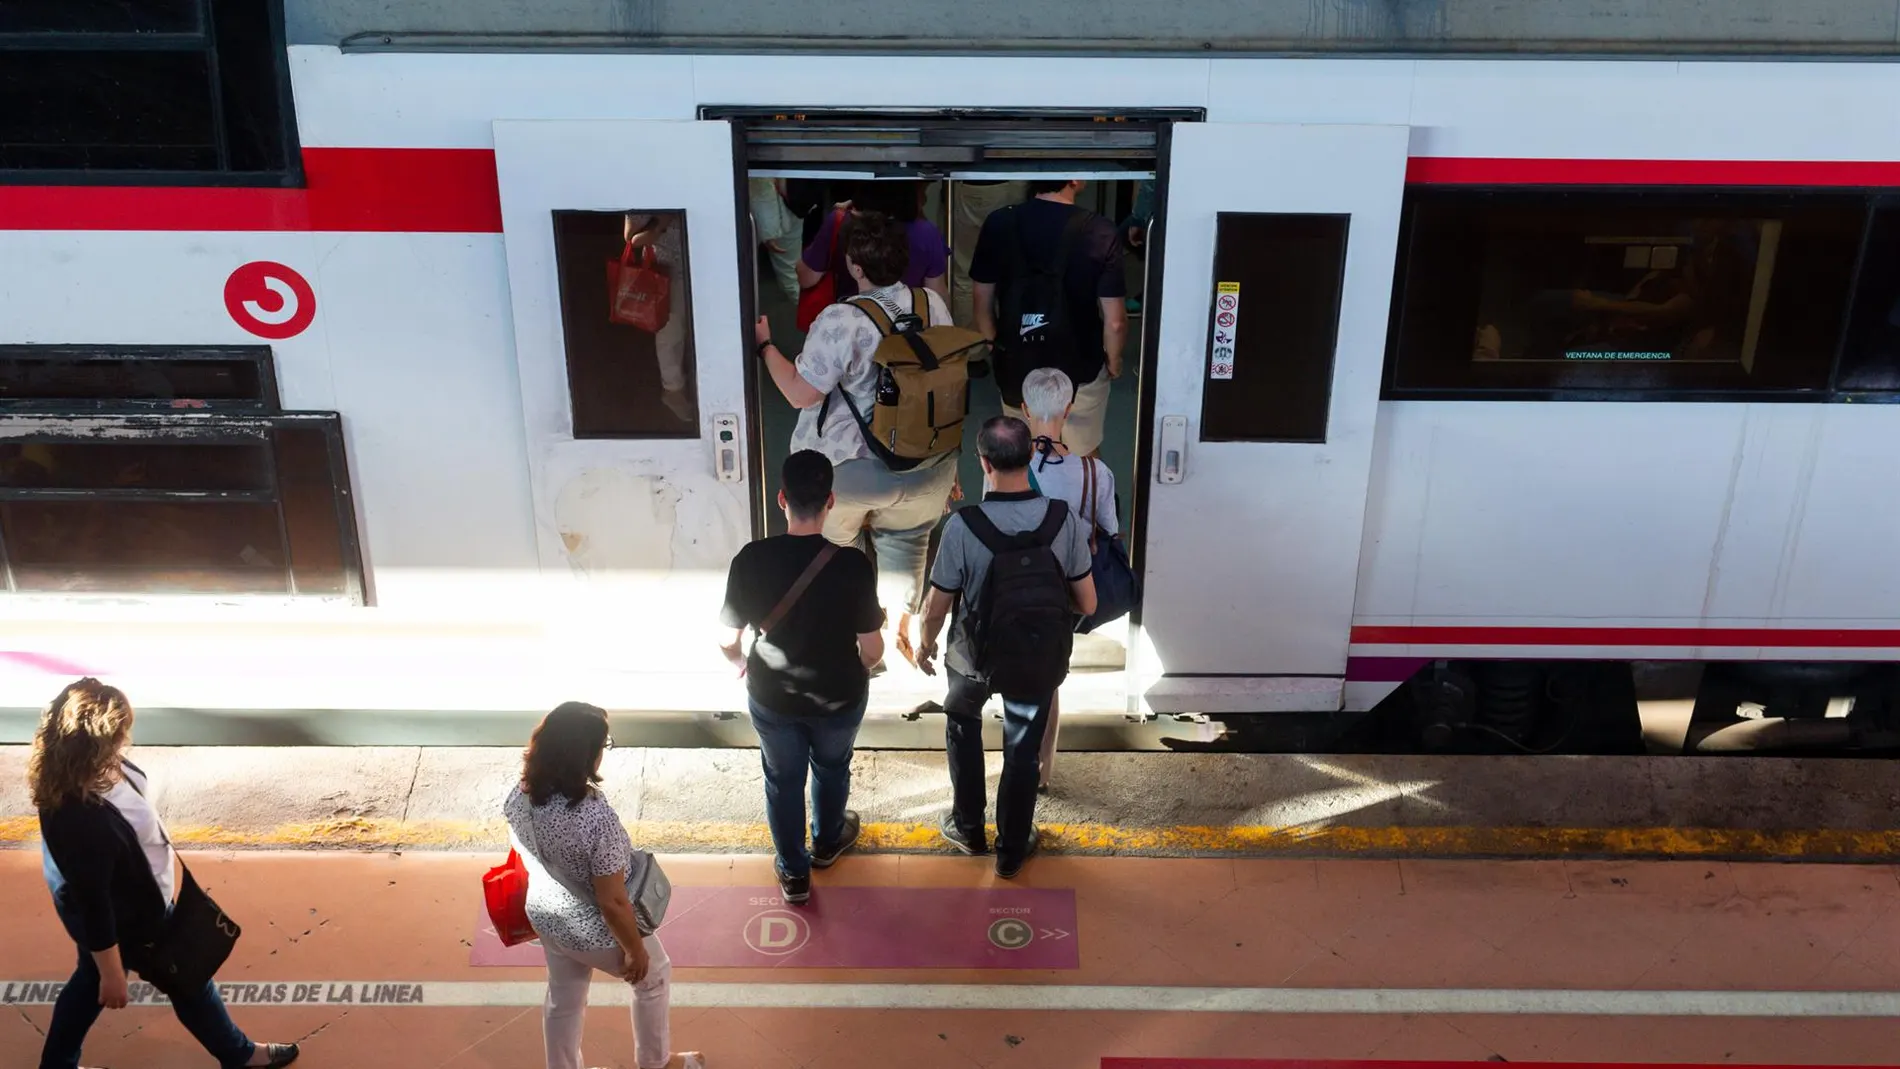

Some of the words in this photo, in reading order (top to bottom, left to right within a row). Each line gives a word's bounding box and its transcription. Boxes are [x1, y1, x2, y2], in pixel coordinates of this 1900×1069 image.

[1021, 313, 1045, 326] NIKE
[1565, 351, 1602, 360] VENTANA
[1604, 351, 1616, 360] DE
[1617, 351, 1671, 360] EMERGENCIA
[748, 896, 787, 907] SECT
[760, 917, 798, 948] D
[997, 922, 1024, 945] C
[3, 983, 66, 1002] LINE
[217, 983, 288, 1004] ETRAS
[291, 983, 323, 1004] DE
[326, 983, 354, 1004] LA
[359, 983, 425, 1004] LINEA
